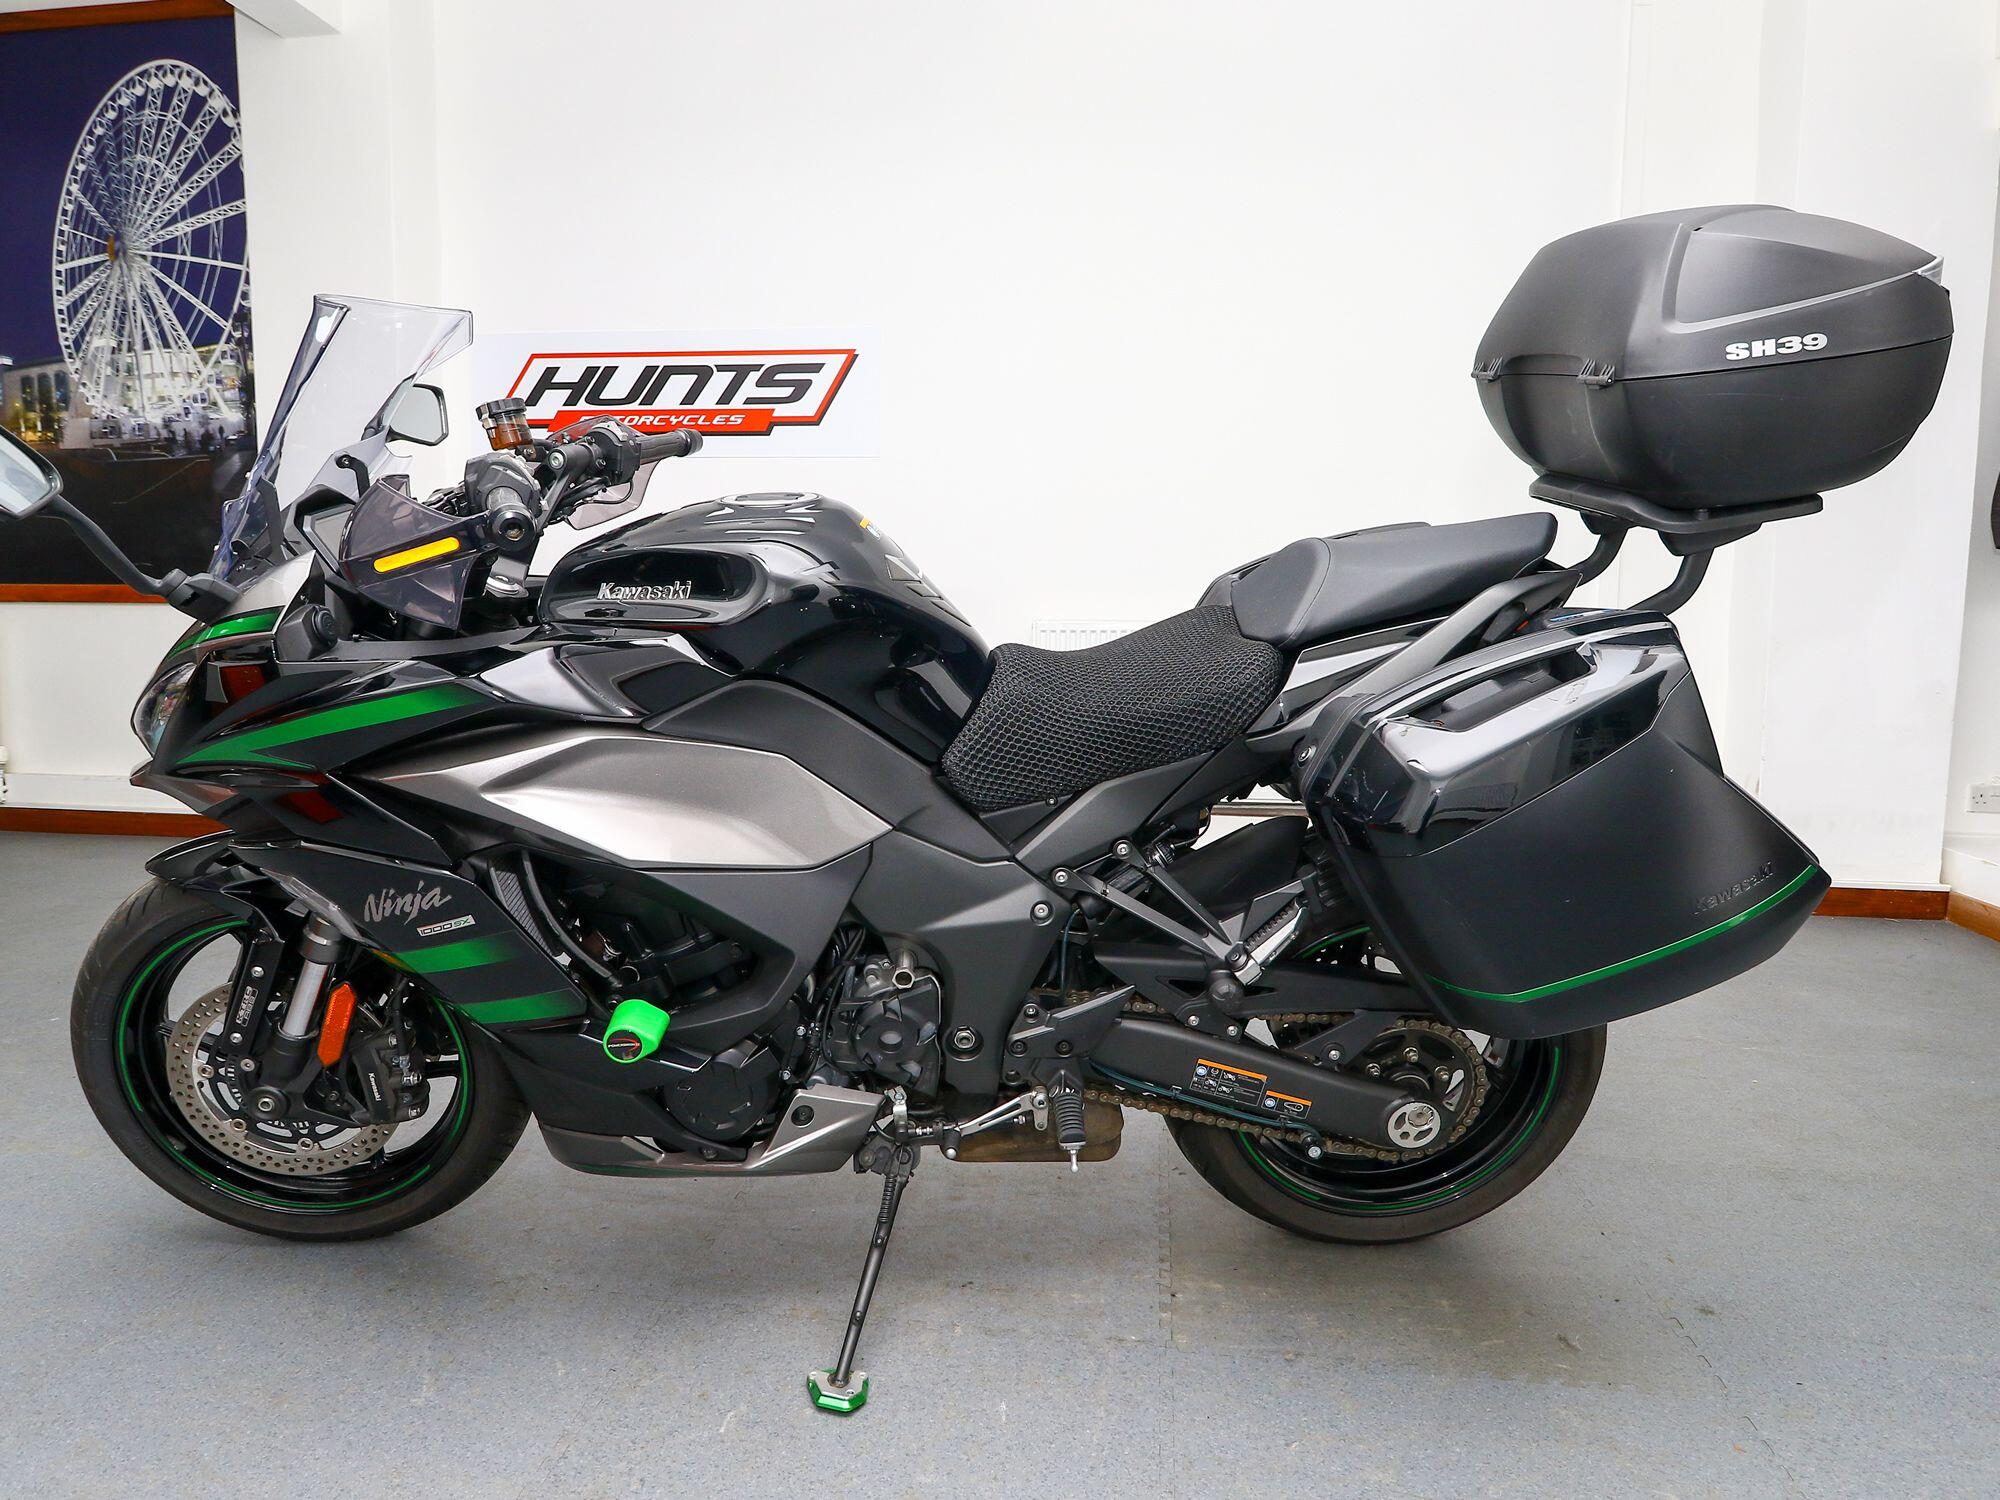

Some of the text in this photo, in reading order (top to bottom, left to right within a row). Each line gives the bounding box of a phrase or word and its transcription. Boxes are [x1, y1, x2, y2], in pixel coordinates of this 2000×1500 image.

[1725, 333, 1828, 361] SH39
[525, 363, 826, 407] HUNTS
[579, 414, 746, 426] ORCYCLES
[596, 580, 692, 600] Kawasaki
[363, 880, 452, 926] Ninja
